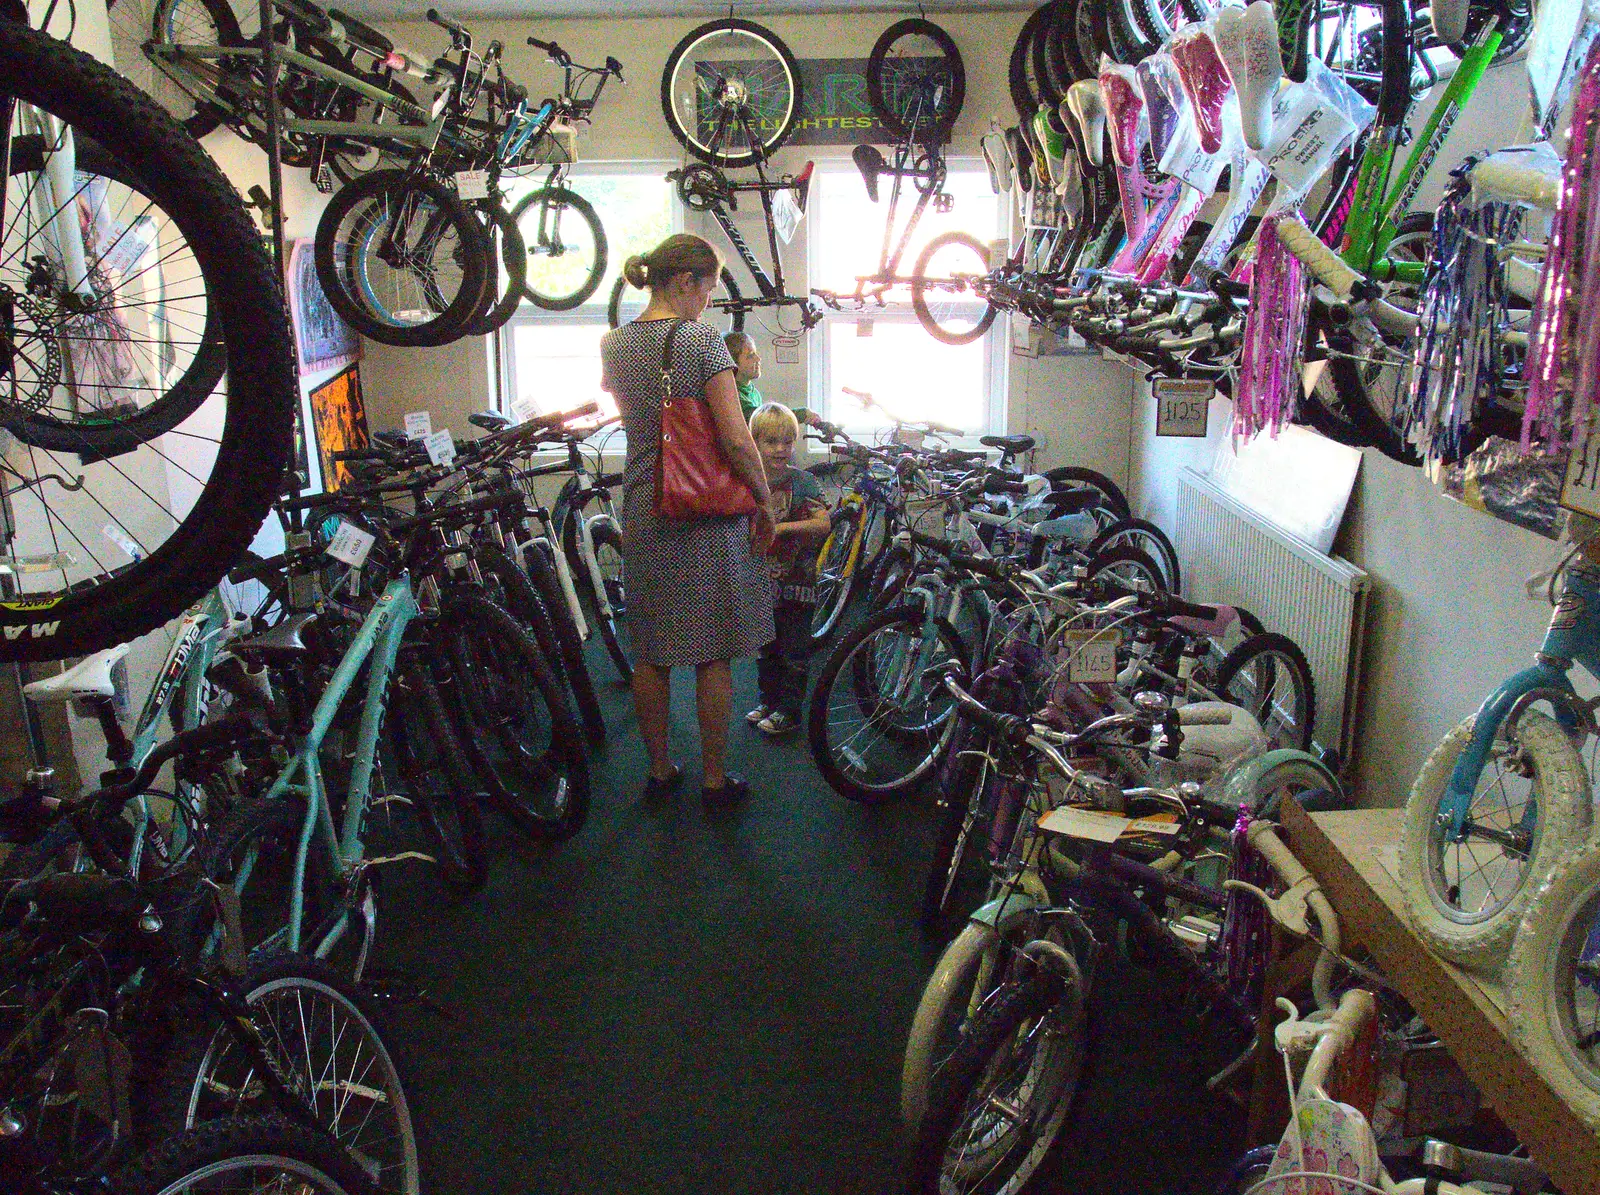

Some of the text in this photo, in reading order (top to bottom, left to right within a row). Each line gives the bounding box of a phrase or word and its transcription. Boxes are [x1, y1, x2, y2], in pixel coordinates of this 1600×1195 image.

[460, 172, 481, 181] SALE
[1391, 100, 1459, 229] PROBIKE
[1229, 166, 1269, 243] Probik
[719, 214, 764, 274] PYTHON
[1163, 400, 1201, 422] £125
